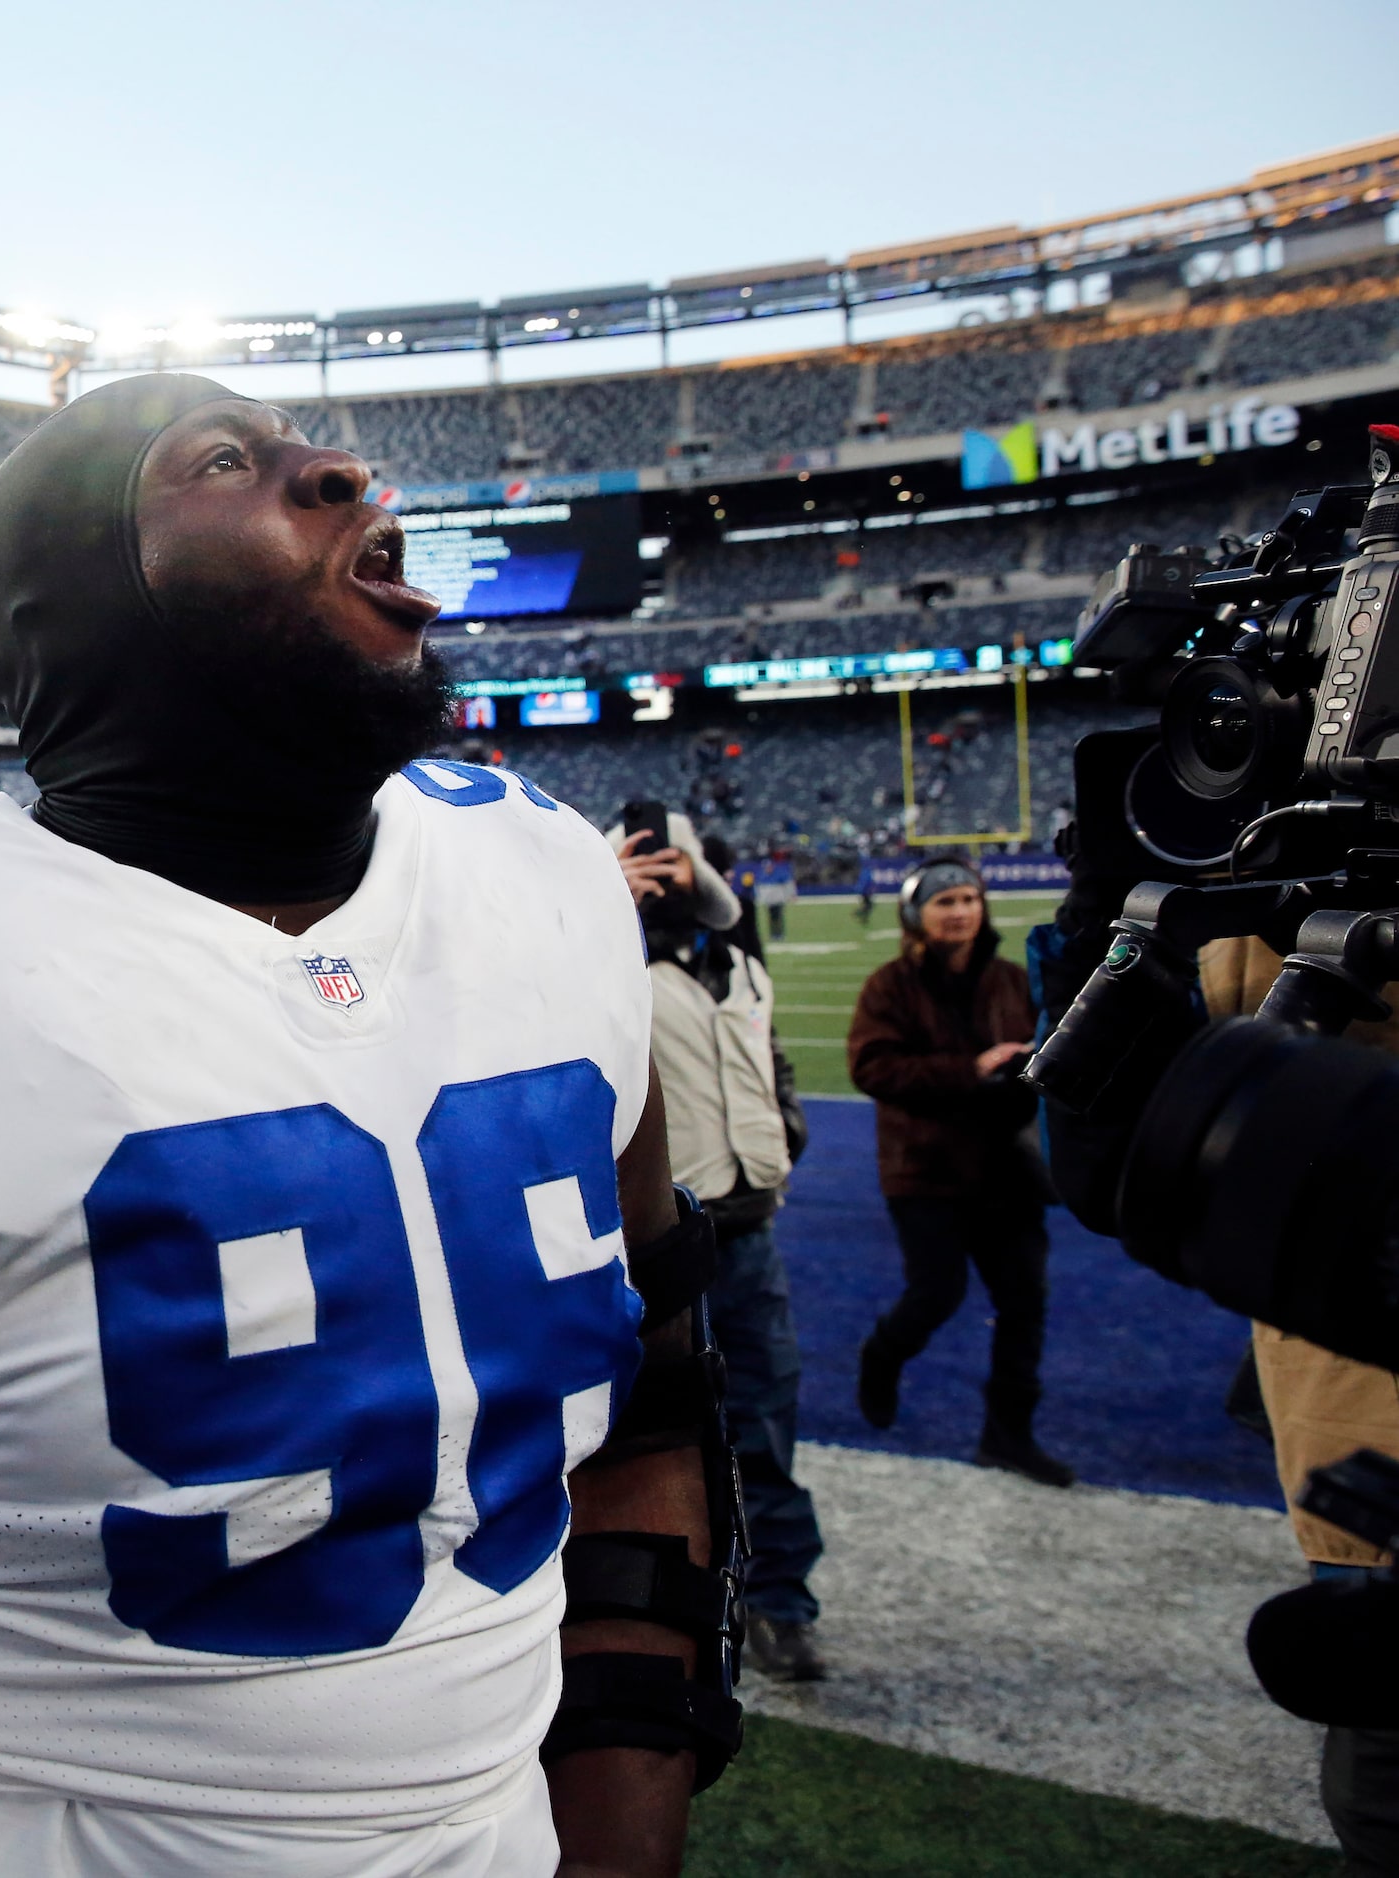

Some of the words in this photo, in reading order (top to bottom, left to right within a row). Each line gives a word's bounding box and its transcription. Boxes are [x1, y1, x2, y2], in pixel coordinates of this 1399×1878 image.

[1041, 396, 1300, 478] MetLife
[316, 975, 359, 1001] NFL
[84, 1058, 646, 1657] 96
